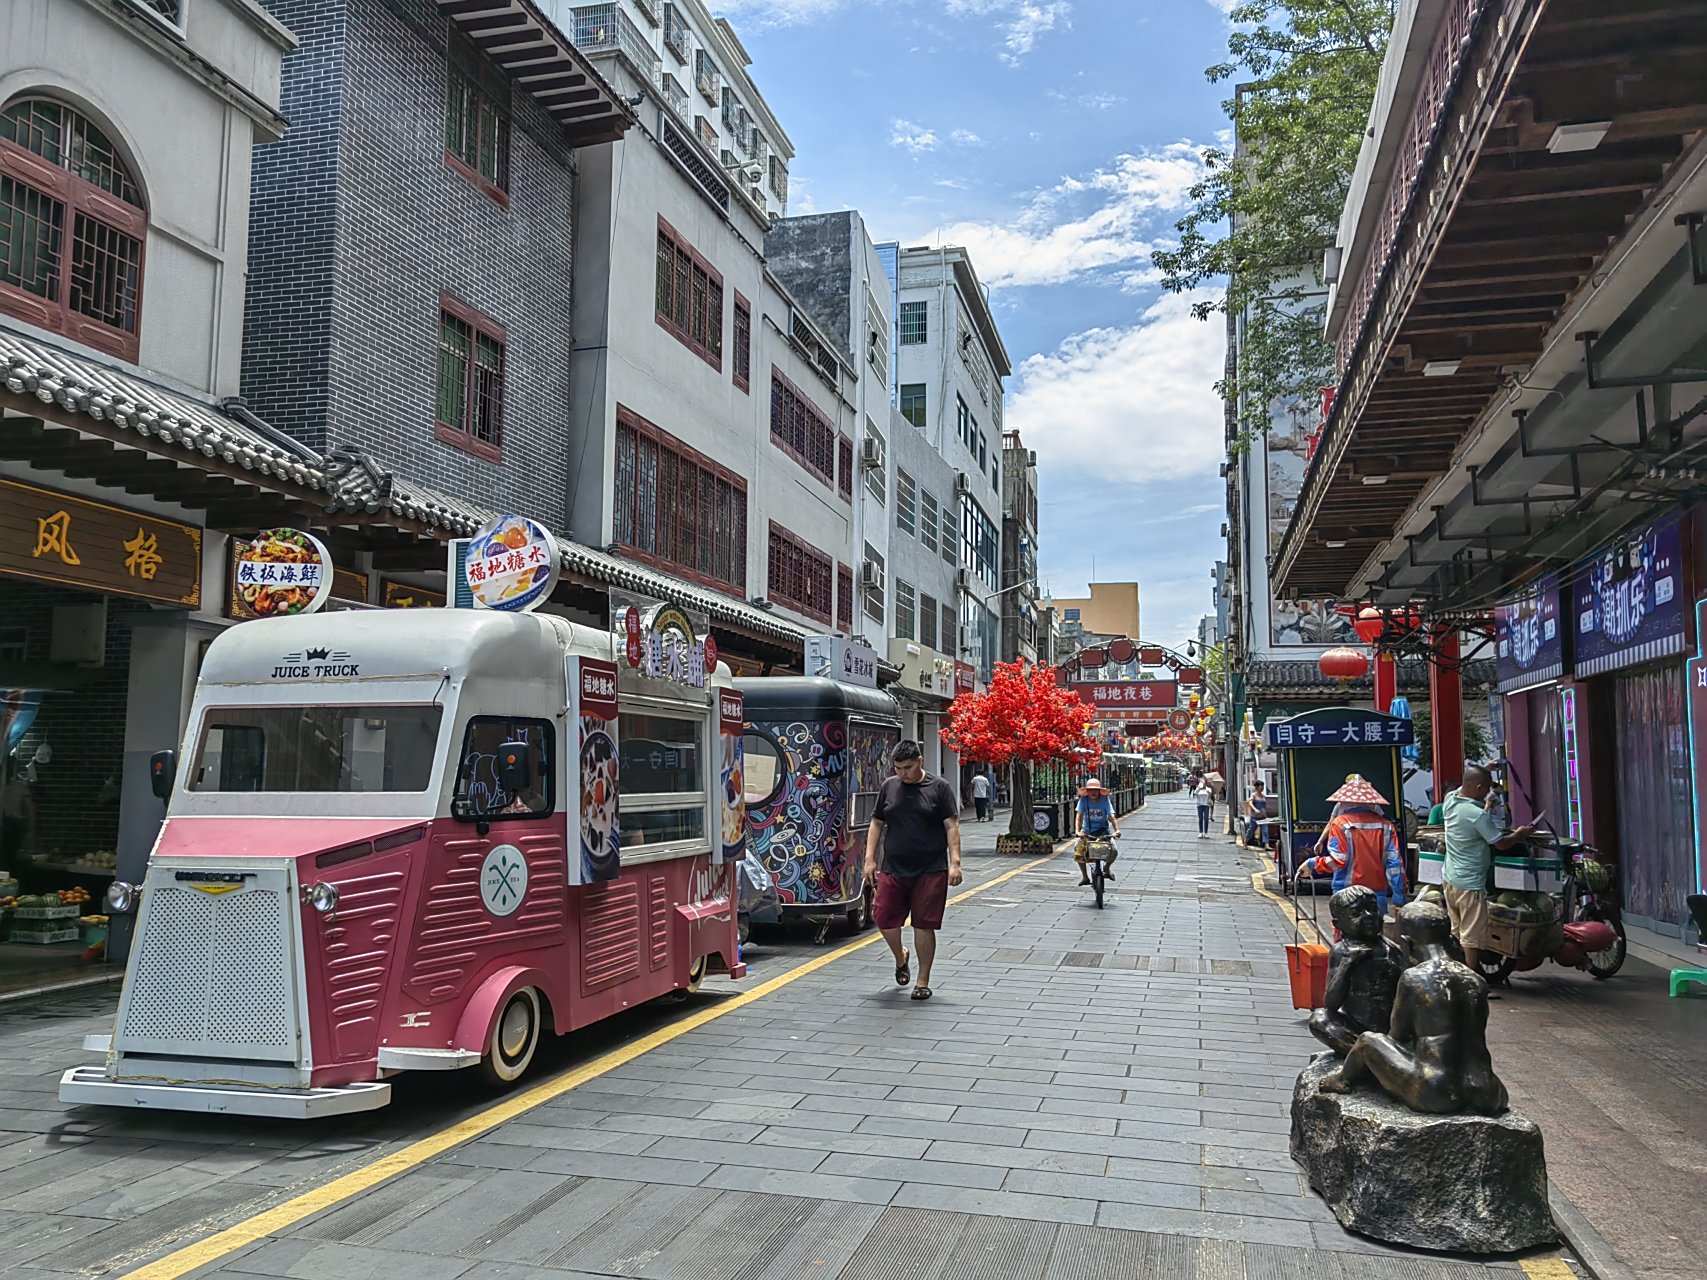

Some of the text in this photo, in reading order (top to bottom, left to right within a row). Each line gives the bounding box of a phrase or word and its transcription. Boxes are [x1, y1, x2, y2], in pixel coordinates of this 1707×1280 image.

[32, 510, 163, 580] 风格
[239, 563, 319, 585] 铁板海鲜
[468, 545, 546, 583] 福地糖水
[628, 614, 639, 661] 福地
[271, 664, 360, 678] JUICE TRUCK
[853, 656, 874, 679] 雪花冰城
[583, 674, 615, 696] 福地糖水
[1092, 686, 1153, 700] 福地夜巷
[722, 701, 742, 719] 福地糖水
[1276, 721, 1405, 744] 闫守一大腰子
